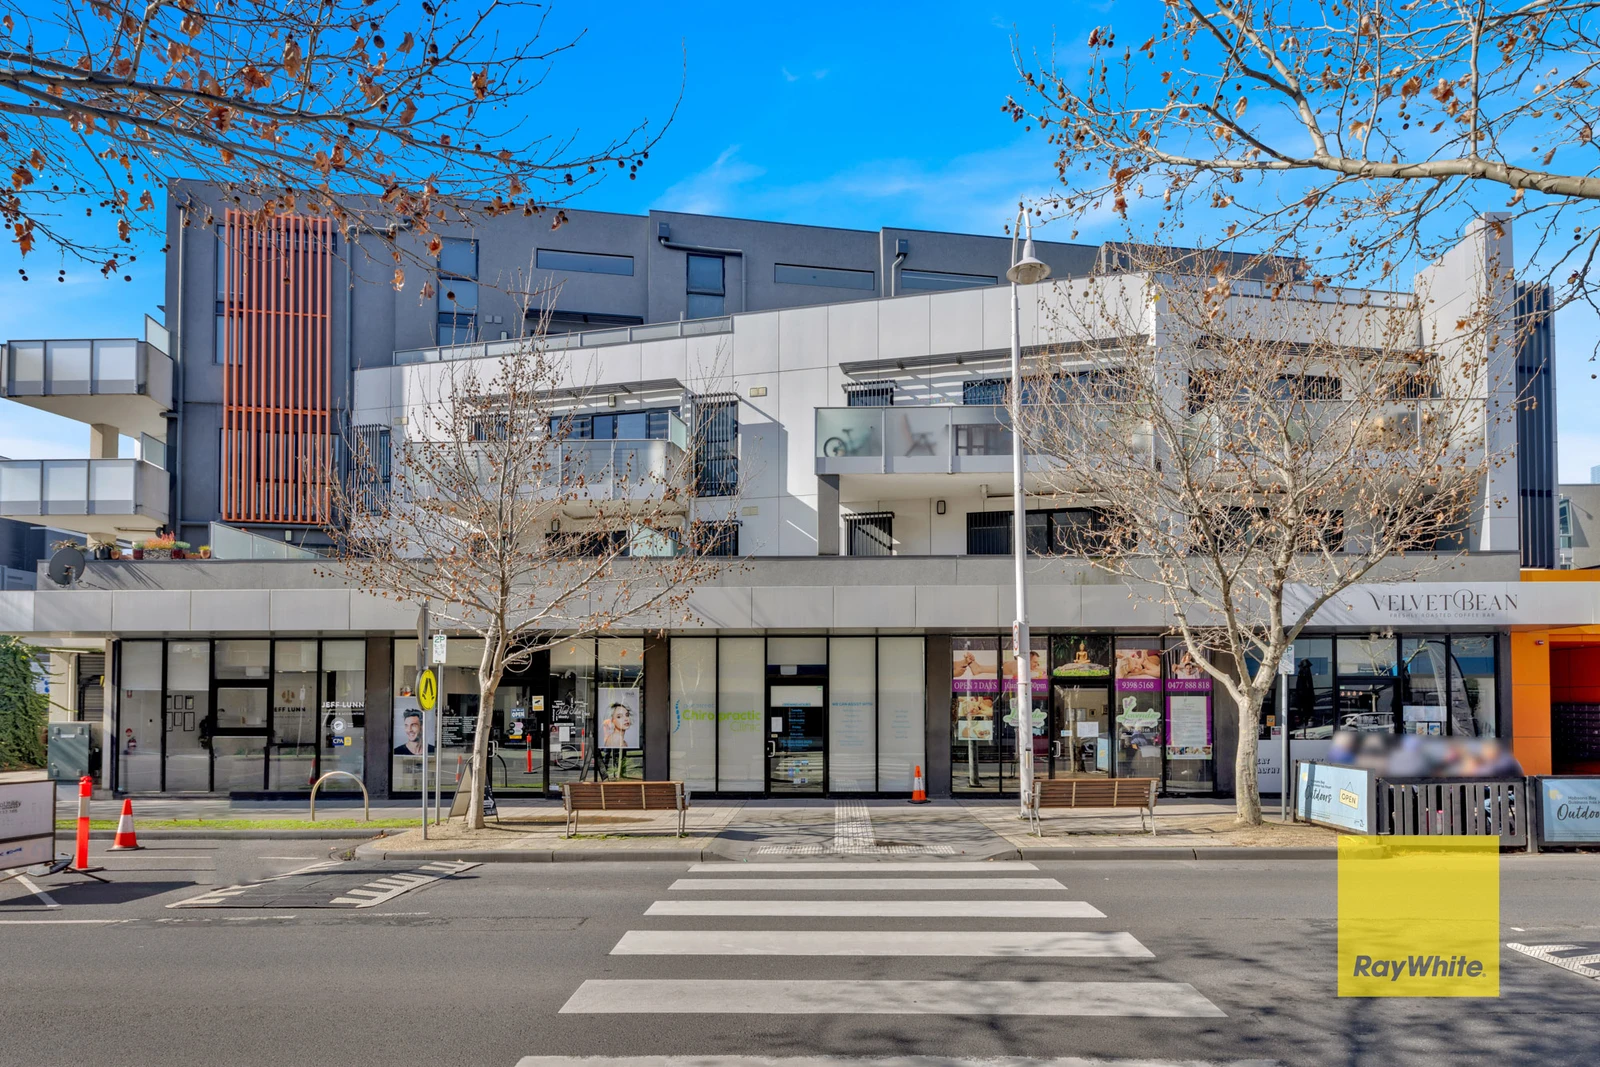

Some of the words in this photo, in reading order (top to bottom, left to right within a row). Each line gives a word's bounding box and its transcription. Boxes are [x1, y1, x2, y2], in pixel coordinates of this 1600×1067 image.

[953, 682, 973, 690] OPEN
[980, 682, 997, 690] DAYS
[1122, 681, 1138, 689] 9398
[1138, 681, 1154, 689] 5168
[1168, 681, 1184, 689] 0477
[1185, 681, 1197, 689] 888
[1198, 681, 1210, 689] 818
[729, 720, 761, 732] Clinic
[1341, 793, 1357, 805] OPEN
